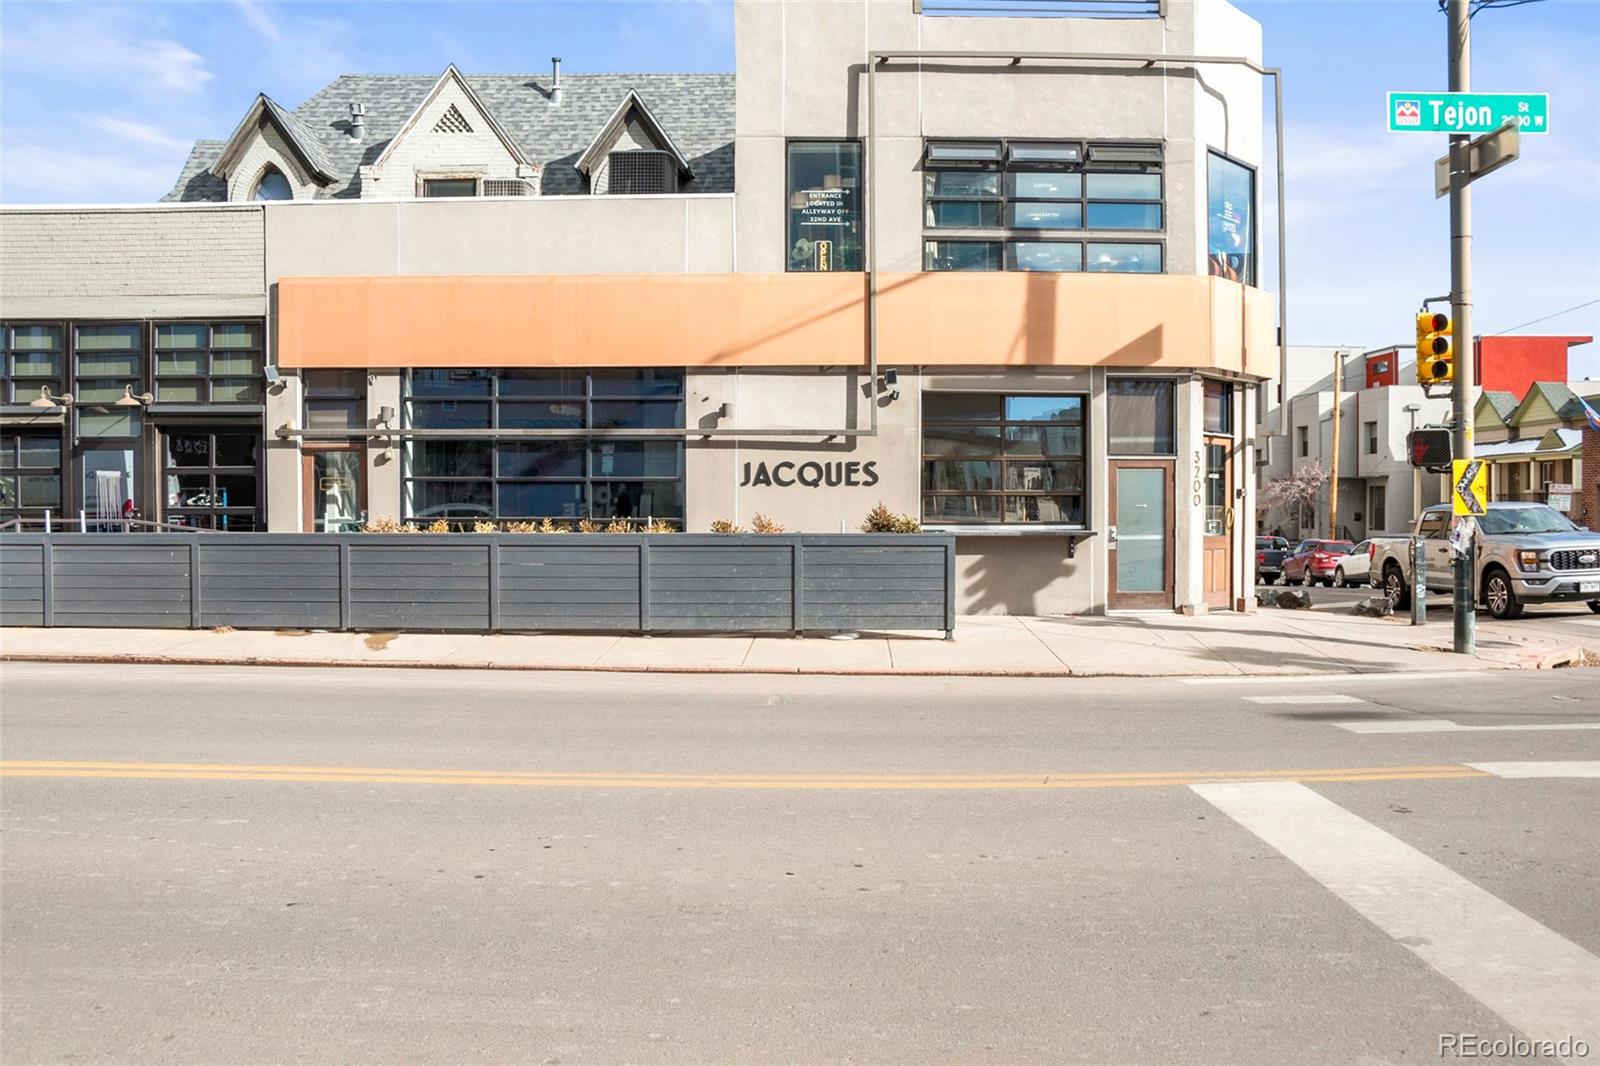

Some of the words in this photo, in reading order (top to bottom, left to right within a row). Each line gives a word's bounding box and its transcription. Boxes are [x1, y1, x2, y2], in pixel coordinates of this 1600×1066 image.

[1428, 100, 1493, 130] Tejon
[1517, 101, 1529, 112] St
[1534, 115, 1544, 127] W
[820, 241, 828, 271] OPEN
[740, 461, 880, 488] JACQUES
[1193, 450, 1202, 507] 3200
